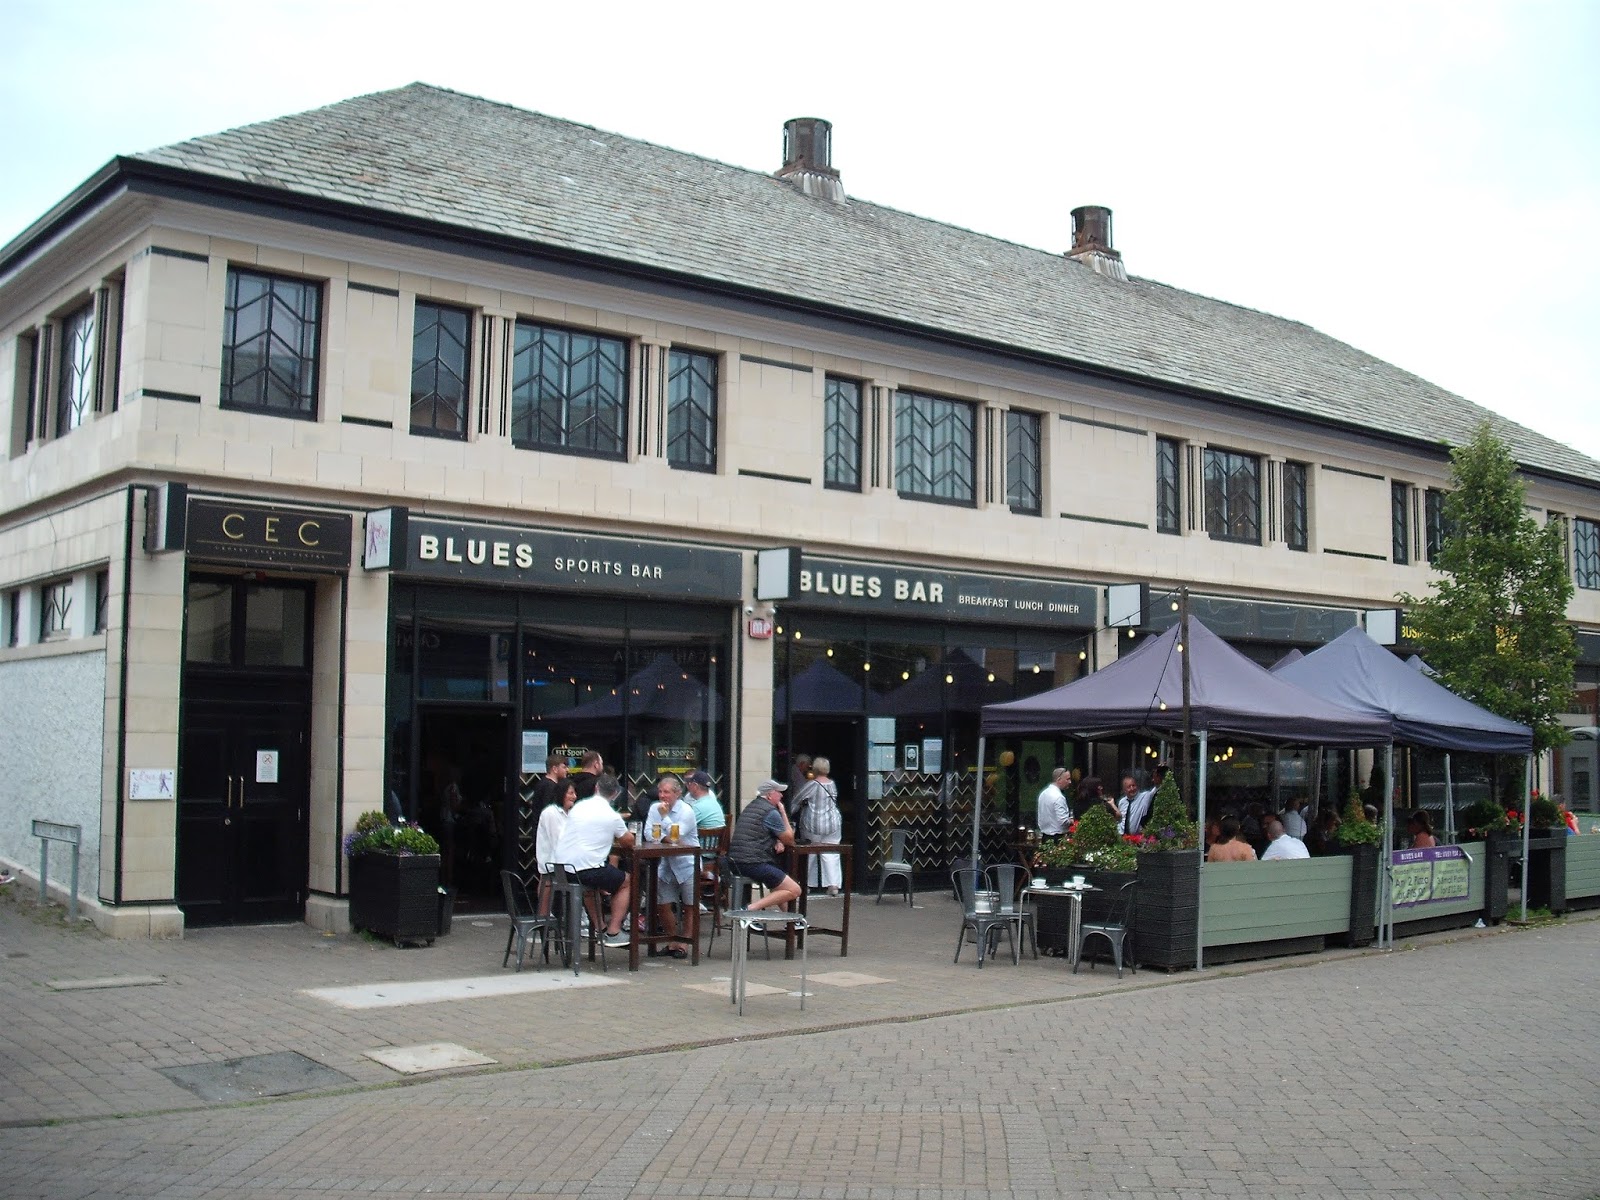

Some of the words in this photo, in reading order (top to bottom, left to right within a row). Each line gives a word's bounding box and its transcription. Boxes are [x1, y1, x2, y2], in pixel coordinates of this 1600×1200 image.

[222, 513, 320, 546] CEC
[419, 534, 533, 568] BLUES
[554, 557, 622, 576] SPORTS
[631, 564, 662, 579] BAR
[800, 570, 882, 598] BLUES
[894, 579, 944, 603] BAR
[958, 594, 1009, 608] BREAKFAST
[1014, 600, 1044, 611] LUNCH
[1048, 603, 1080, 614] DINNER
[658, 748, 670, 757] sky
[671, 748, 695, 757] sports
